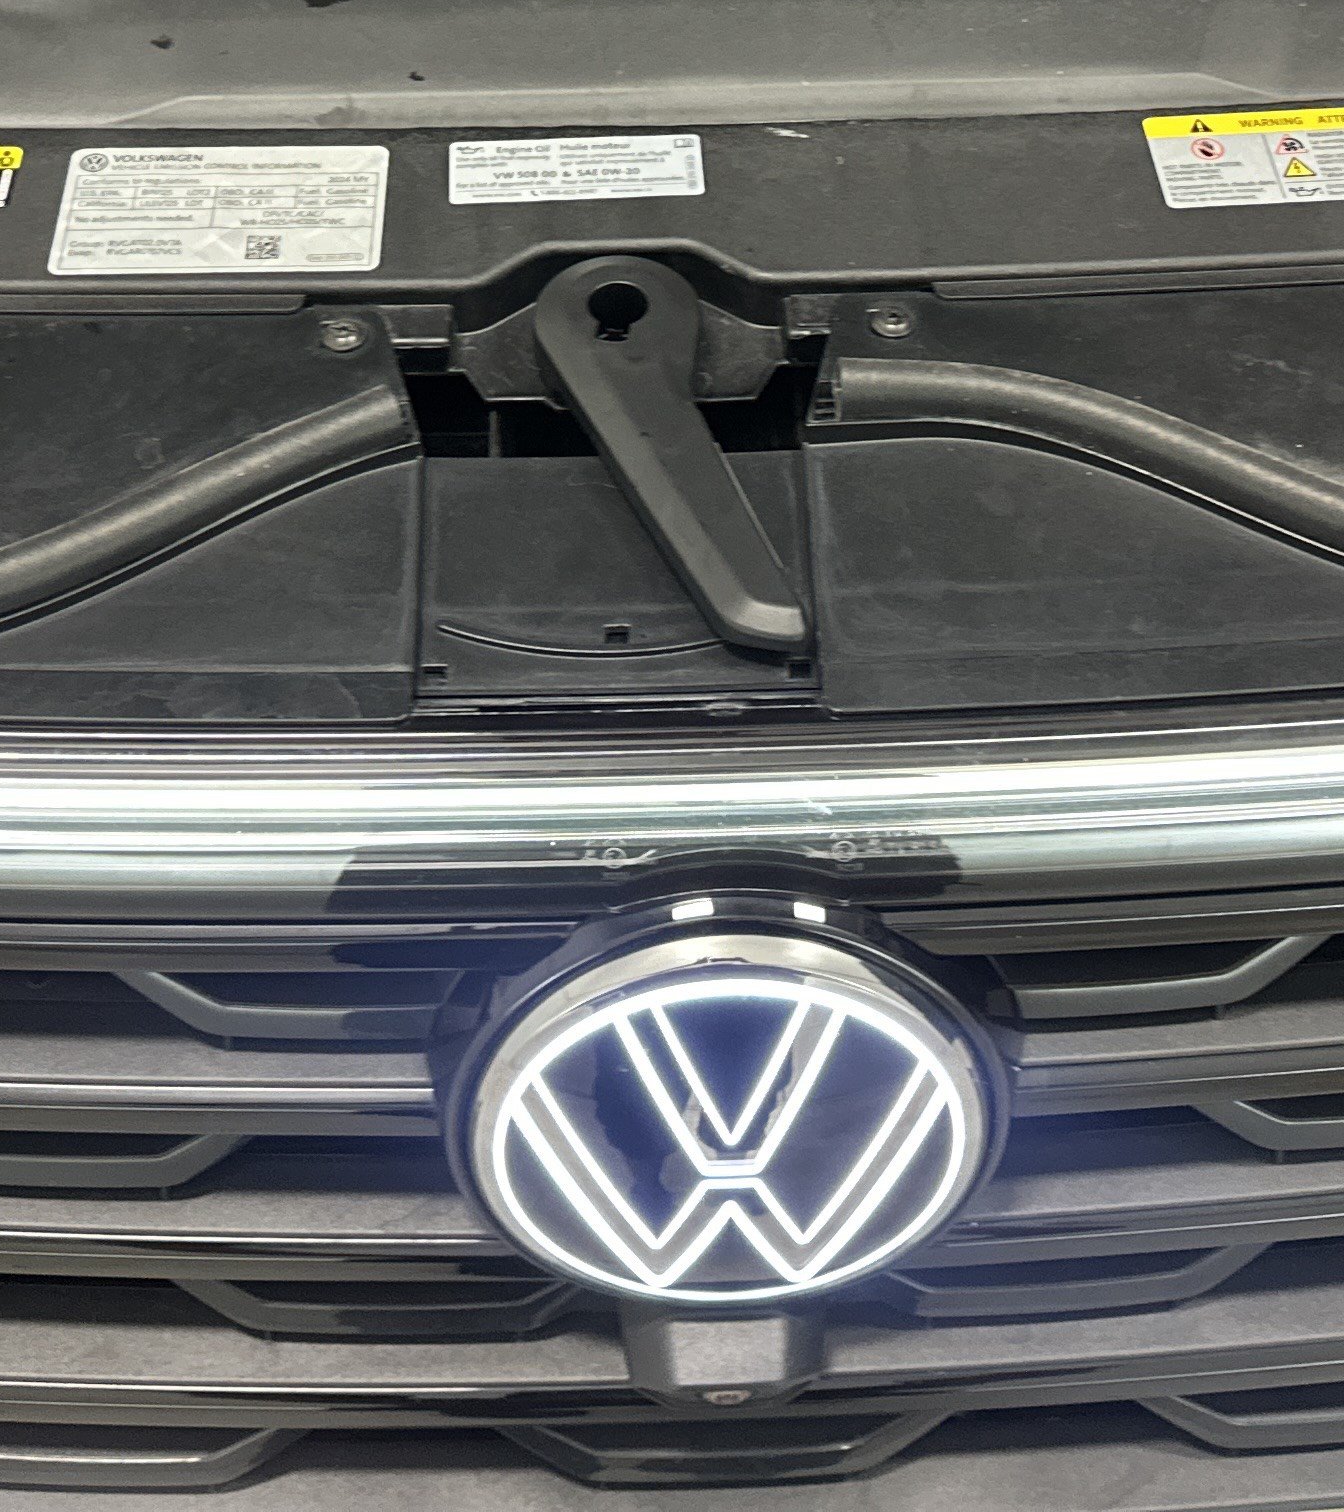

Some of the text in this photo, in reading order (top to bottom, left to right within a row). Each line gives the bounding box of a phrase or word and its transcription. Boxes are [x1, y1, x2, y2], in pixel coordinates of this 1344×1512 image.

[1239, 117, 1304, 128] WARNING
[496, 146, 533, 154] Engine
[113, 154, 204, 162] VOLKSWAGEN
